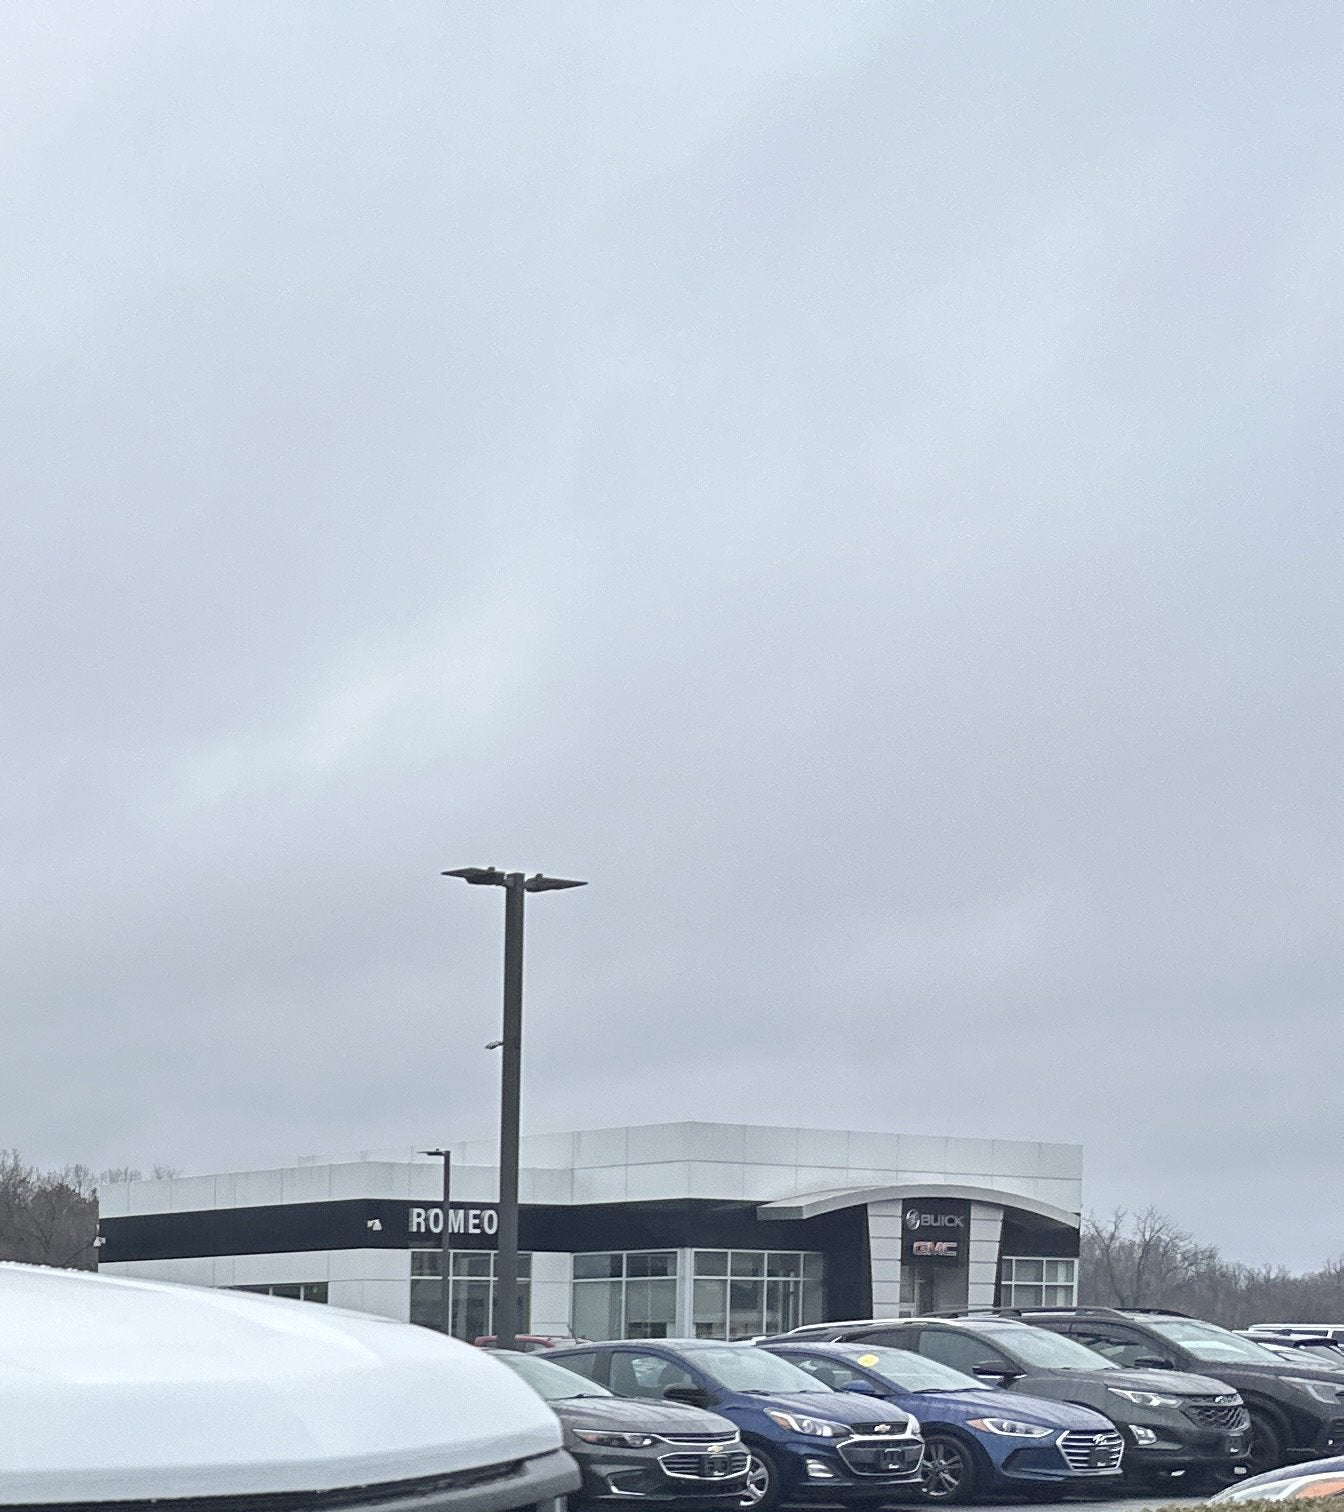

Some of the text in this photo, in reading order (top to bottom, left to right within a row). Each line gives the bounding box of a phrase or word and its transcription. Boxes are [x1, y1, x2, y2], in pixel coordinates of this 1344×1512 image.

[408, 1207, 499, 1235] ROMEO
[921, 1214, 964, 1227] BUICK
[913, 1242, 957, 1256] GMC
